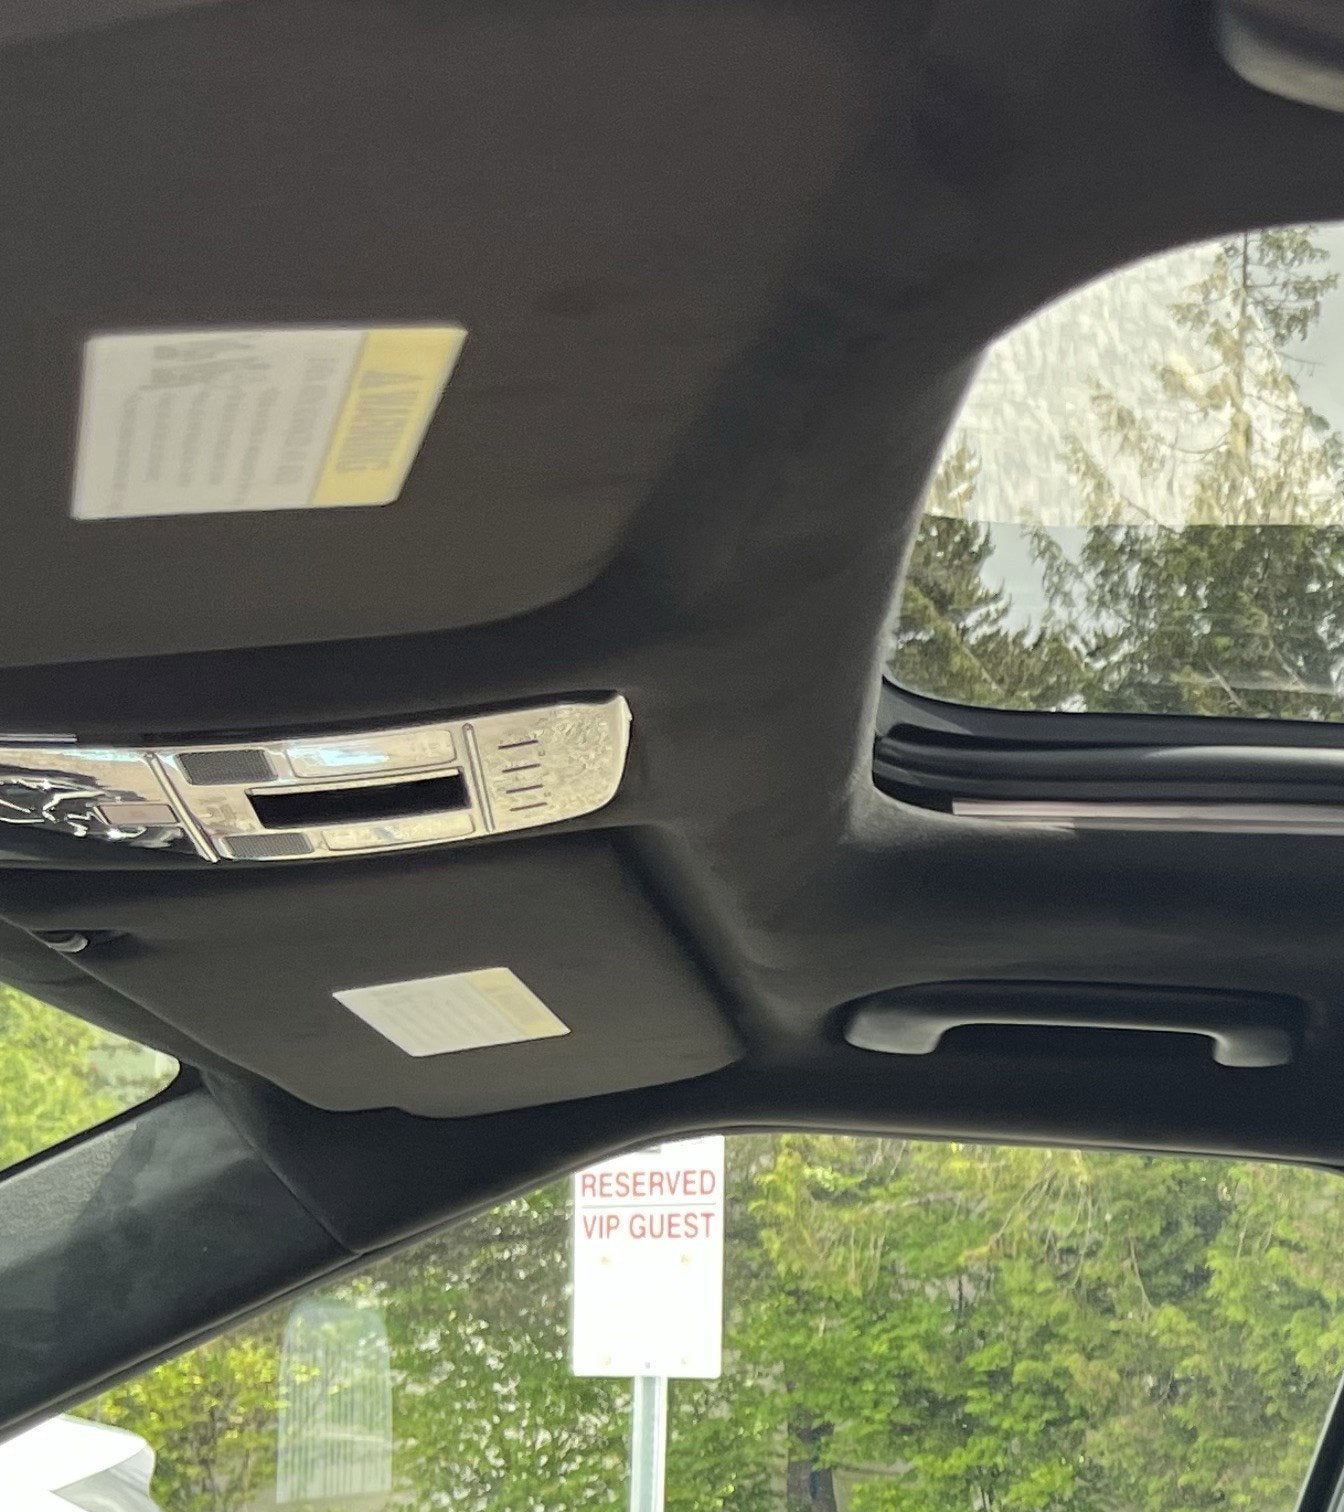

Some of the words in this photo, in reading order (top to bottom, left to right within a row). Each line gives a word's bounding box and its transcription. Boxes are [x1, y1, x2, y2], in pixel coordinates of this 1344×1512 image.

[581, 1169, 716, 1198] RESERVED
[583, 1214, 620, 1239] VIP
[629, 1212, 715, 1239] GUEST
